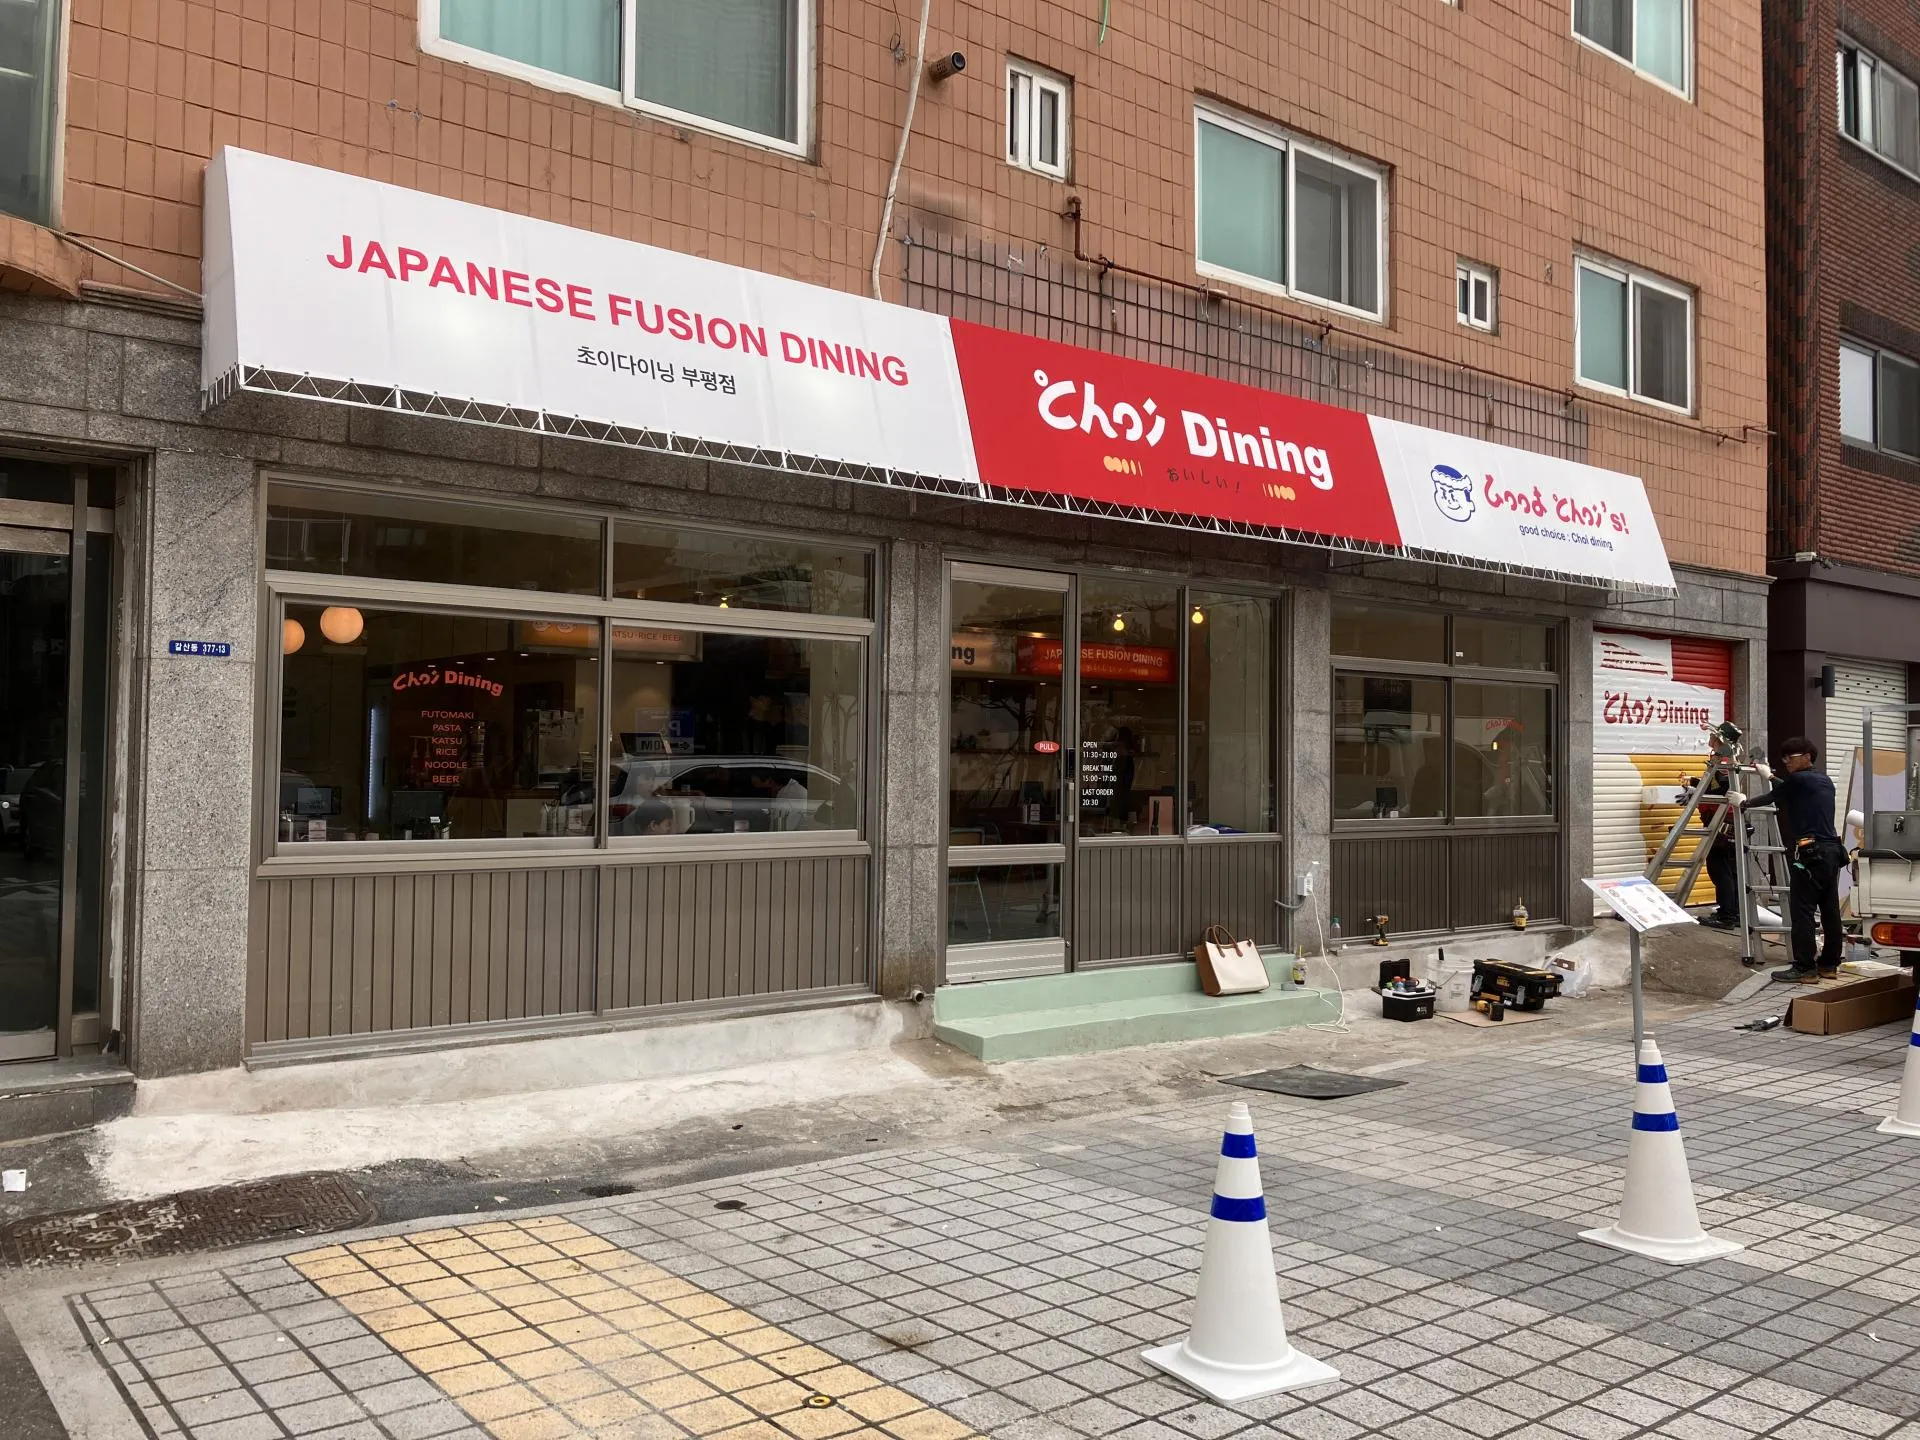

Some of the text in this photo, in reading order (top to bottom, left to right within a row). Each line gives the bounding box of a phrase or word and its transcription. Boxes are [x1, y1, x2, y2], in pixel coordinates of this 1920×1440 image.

[326, 234, 909, 386] JAPANESE FUSION DINING
[577, 345, 736, 395] 초이다이닝 부평점
[1033, 369, 1334, 491] Choi Dining
[1484, 474, 1547, 517] Good
[1519, 524, 1540, 536] good
[1541, 527, 1566, 541] choice
[1571, 532, 1589, 545] Choi
[1590, 536, 1614, 552] dining
[175, 642, 226, 654] 갈산동 377-13
[1045, 648, 1163, 667] JAPSE FUSION DINING
[393, 670, 504, 697] Choi Dining
[421, 710, 475, 719] FUTOMAKI
[1603, 690, 1709, 731] Choi Dining
[432, 724, 462, 732] PASTA
[431, 737, 463, 745] KATSU
[1082, 741, 1098, 749] OPEN
[1039, 742, 1055, 751] PULL
[435, 748, 458, 756] RICE
[424, 761, 468, 769] NOODLE
[1082, 764, 1100, 772] BREAK
[432, 775, 460, 784] BEER
[1082, 798, 1099, 806] 20:30
